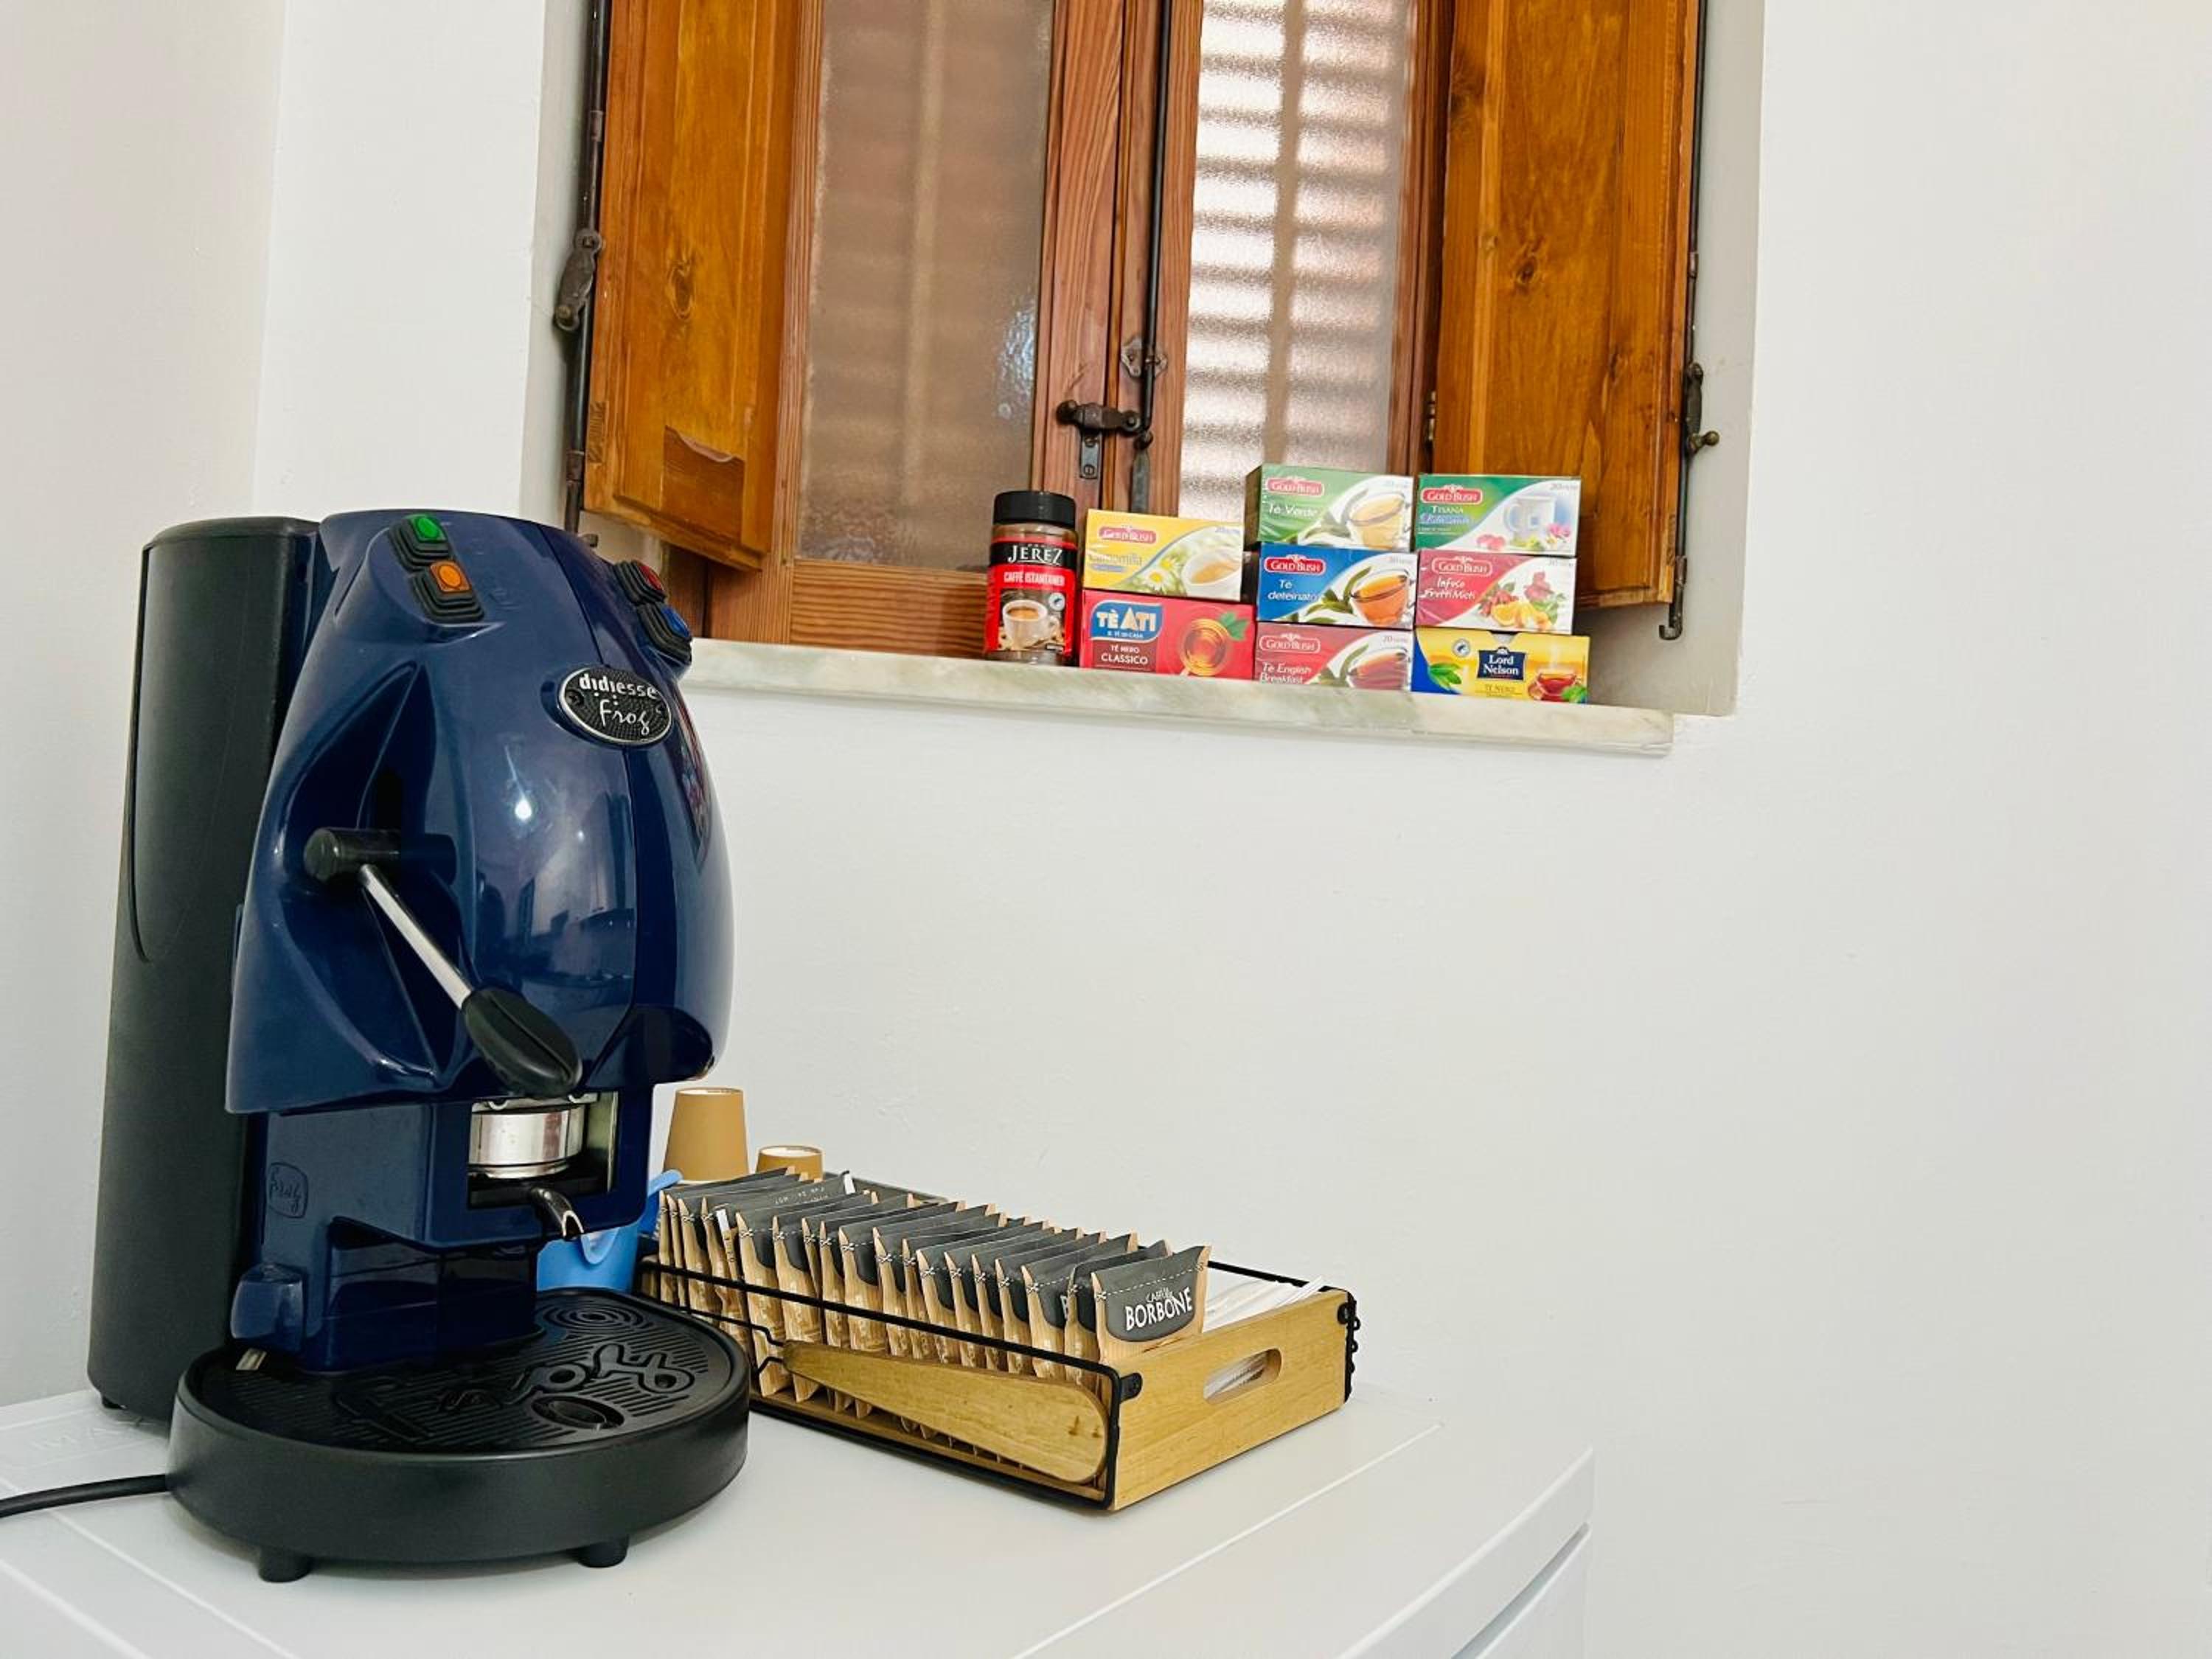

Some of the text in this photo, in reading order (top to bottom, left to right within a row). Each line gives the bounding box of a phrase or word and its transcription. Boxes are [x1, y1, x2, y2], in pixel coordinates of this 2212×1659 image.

[1007, 544, 1062, 566] JEREZ
[1270, 560, 1321, 573] GOLD BUSH
[1100, 653, 1149, 666] CLASSICO
[1489, 654, 1514, 665] Lord
[1483, 664, 1519, 676] Nelson
[579, 672, 659, 700] didiesse
[599, 698, 651, 736] Frog
[1124, 1287, 1193, 1331] BORBONE
